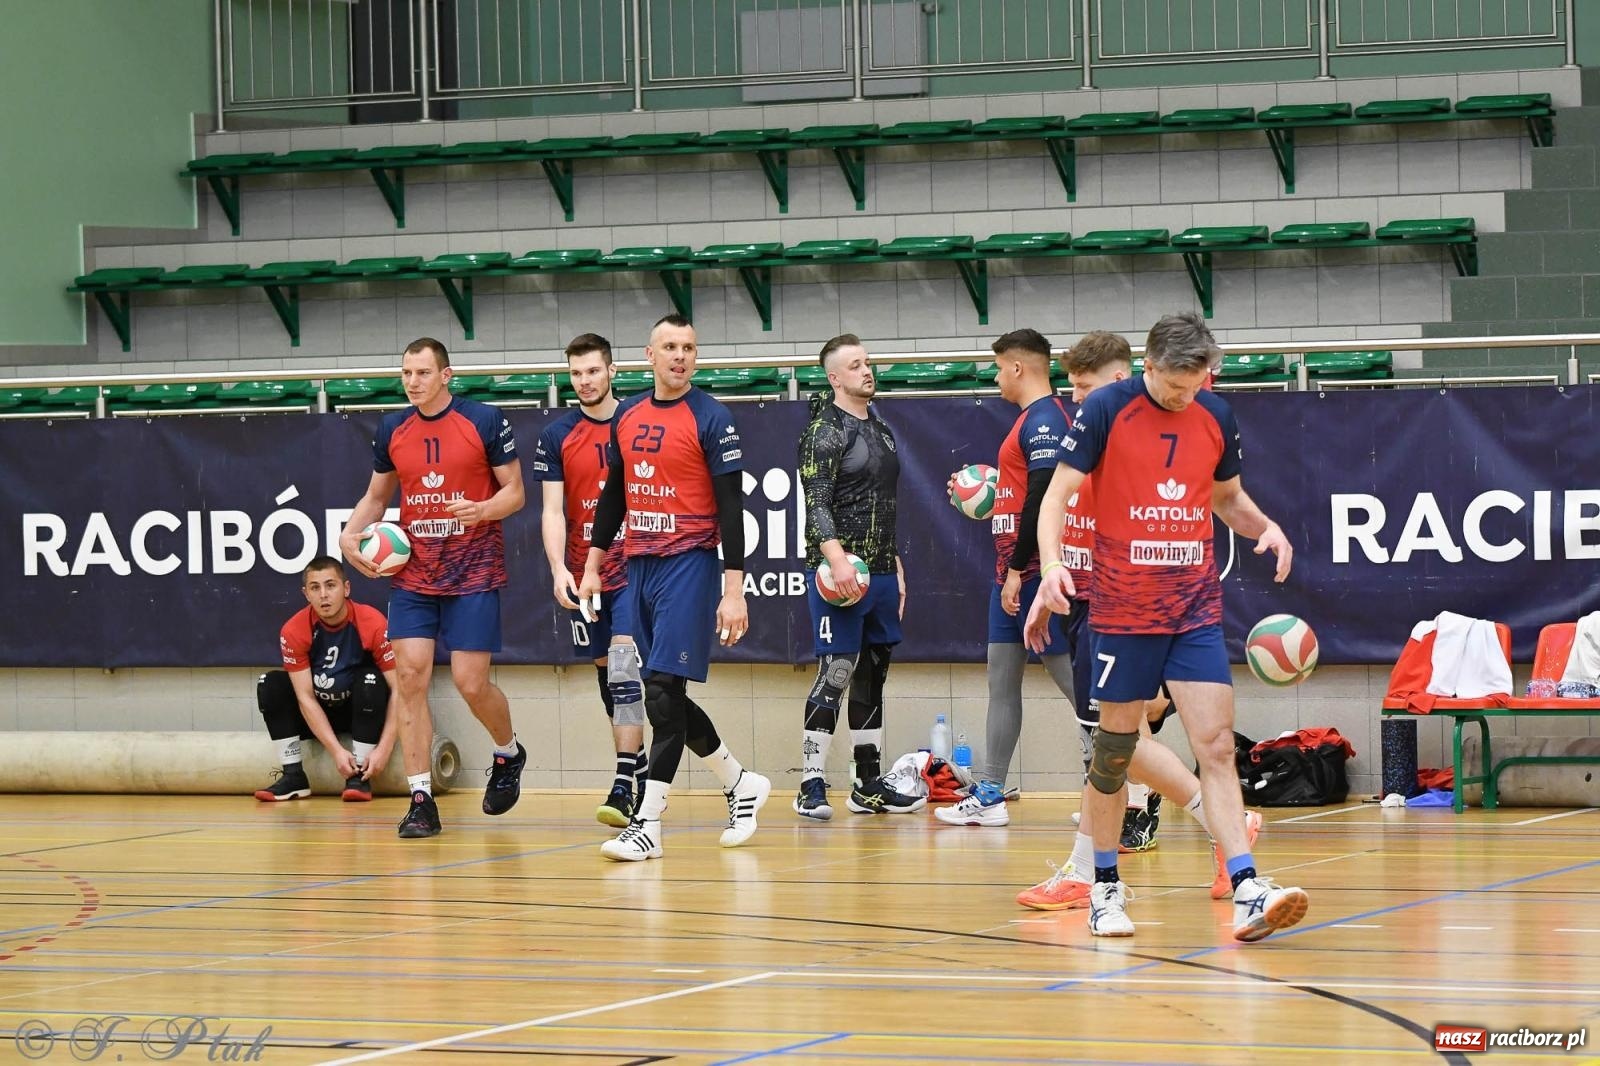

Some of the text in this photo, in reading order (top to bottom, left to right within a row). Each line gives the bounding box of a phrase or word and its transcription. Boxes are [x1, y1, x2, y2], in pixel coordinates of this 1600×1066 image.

[424, 437, 441, 465] 11
[631, 424, 665, 453] 23
[1160, 433, 1179, 469] 7
[1129, 505, 1205, 521] KATOLIK
[1331, 489, 1600, 564] RACIB
[23, 484, 402, 576] RACIBÓ
[1146, 523, 1196, 533] GROUP
[1132, 542, 1202, 566] nowiny.pl
[721, 571, 810, 597] ACIB
[571, 619, 590, 647] 10
[819, 616, 833, 644] 4
[1096, 653, 1116, 690] 7
